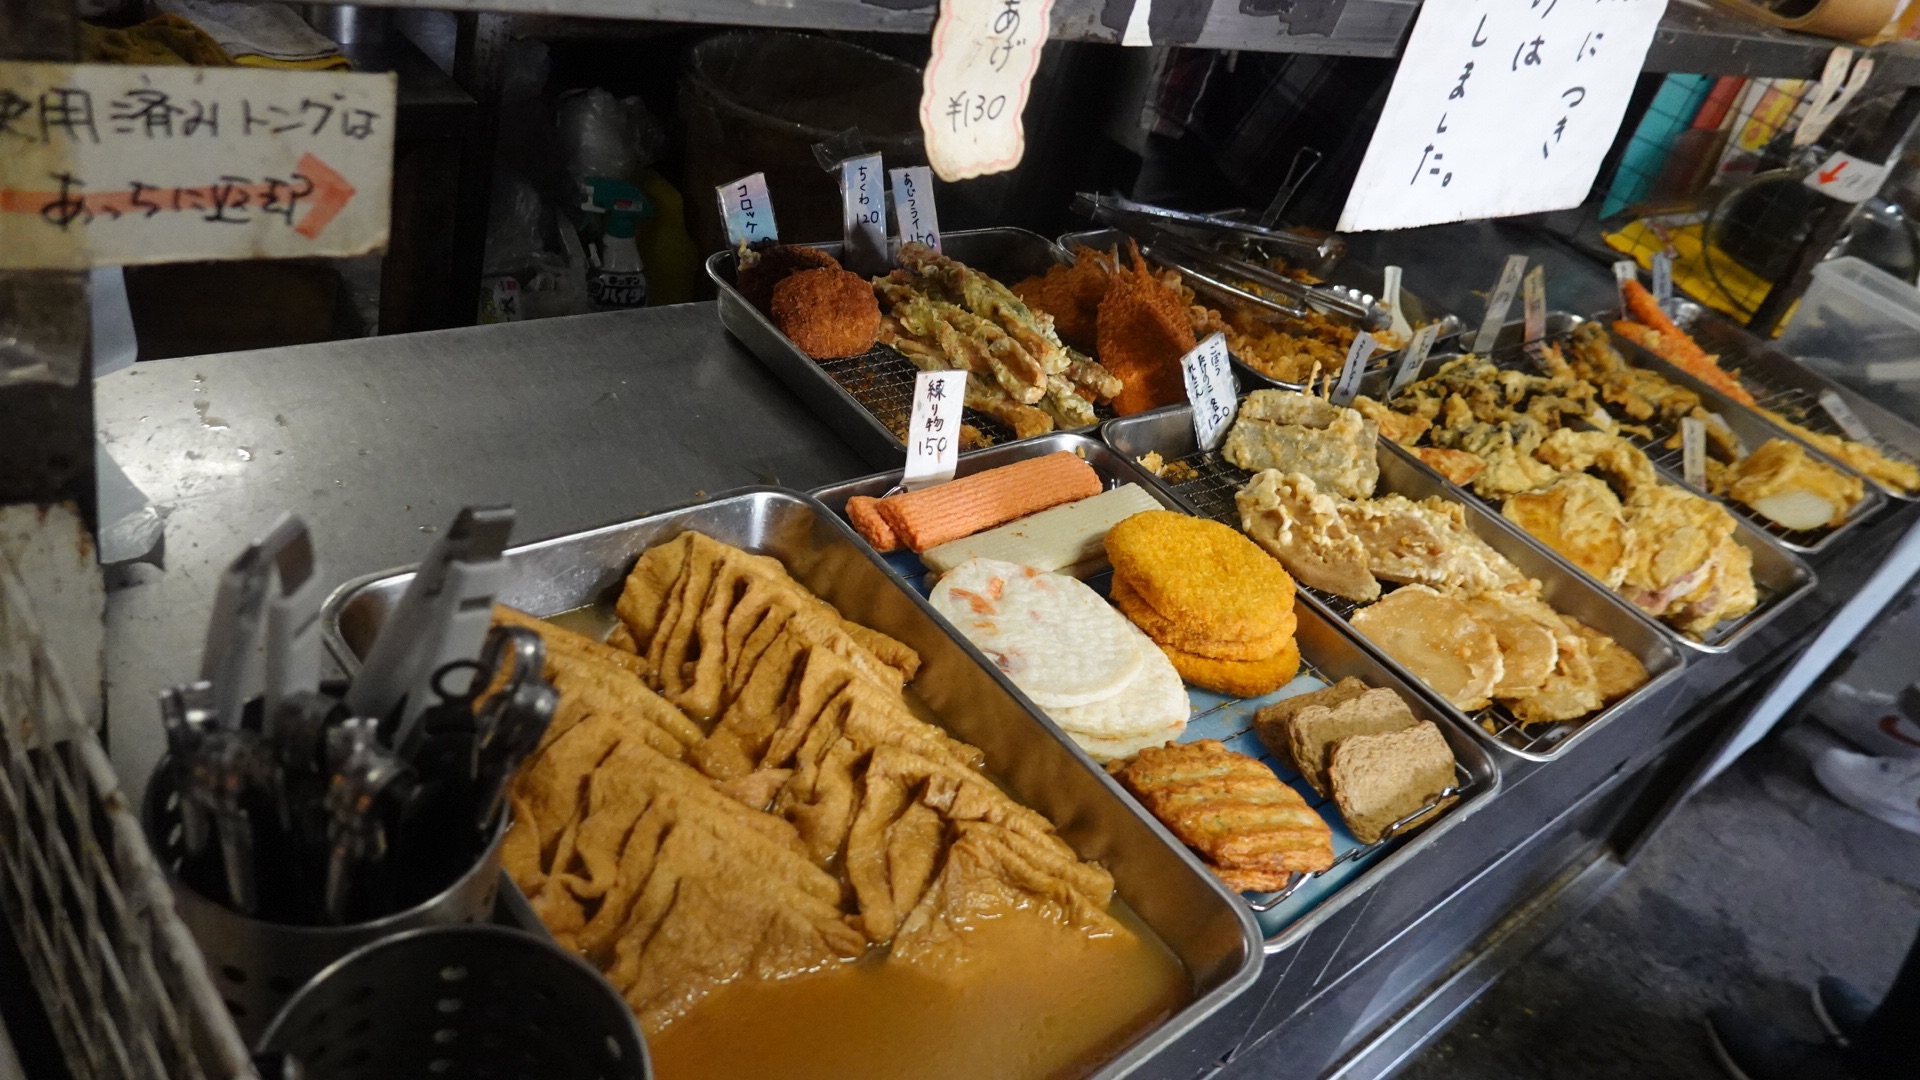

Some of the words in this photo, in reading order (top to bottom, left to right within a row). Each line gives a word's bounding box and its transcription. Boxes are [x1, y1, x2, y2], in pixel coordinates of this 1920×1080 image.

[946, 91, 1006, 133] ¥130
[858, 166, 870, 205] ちくわ
[738, 184, 758, 234] コロッケ
[856, 210, 880, 226] 120
[925, 378, 946, 432] 練り物
[918, 437, 948, 456] 150
